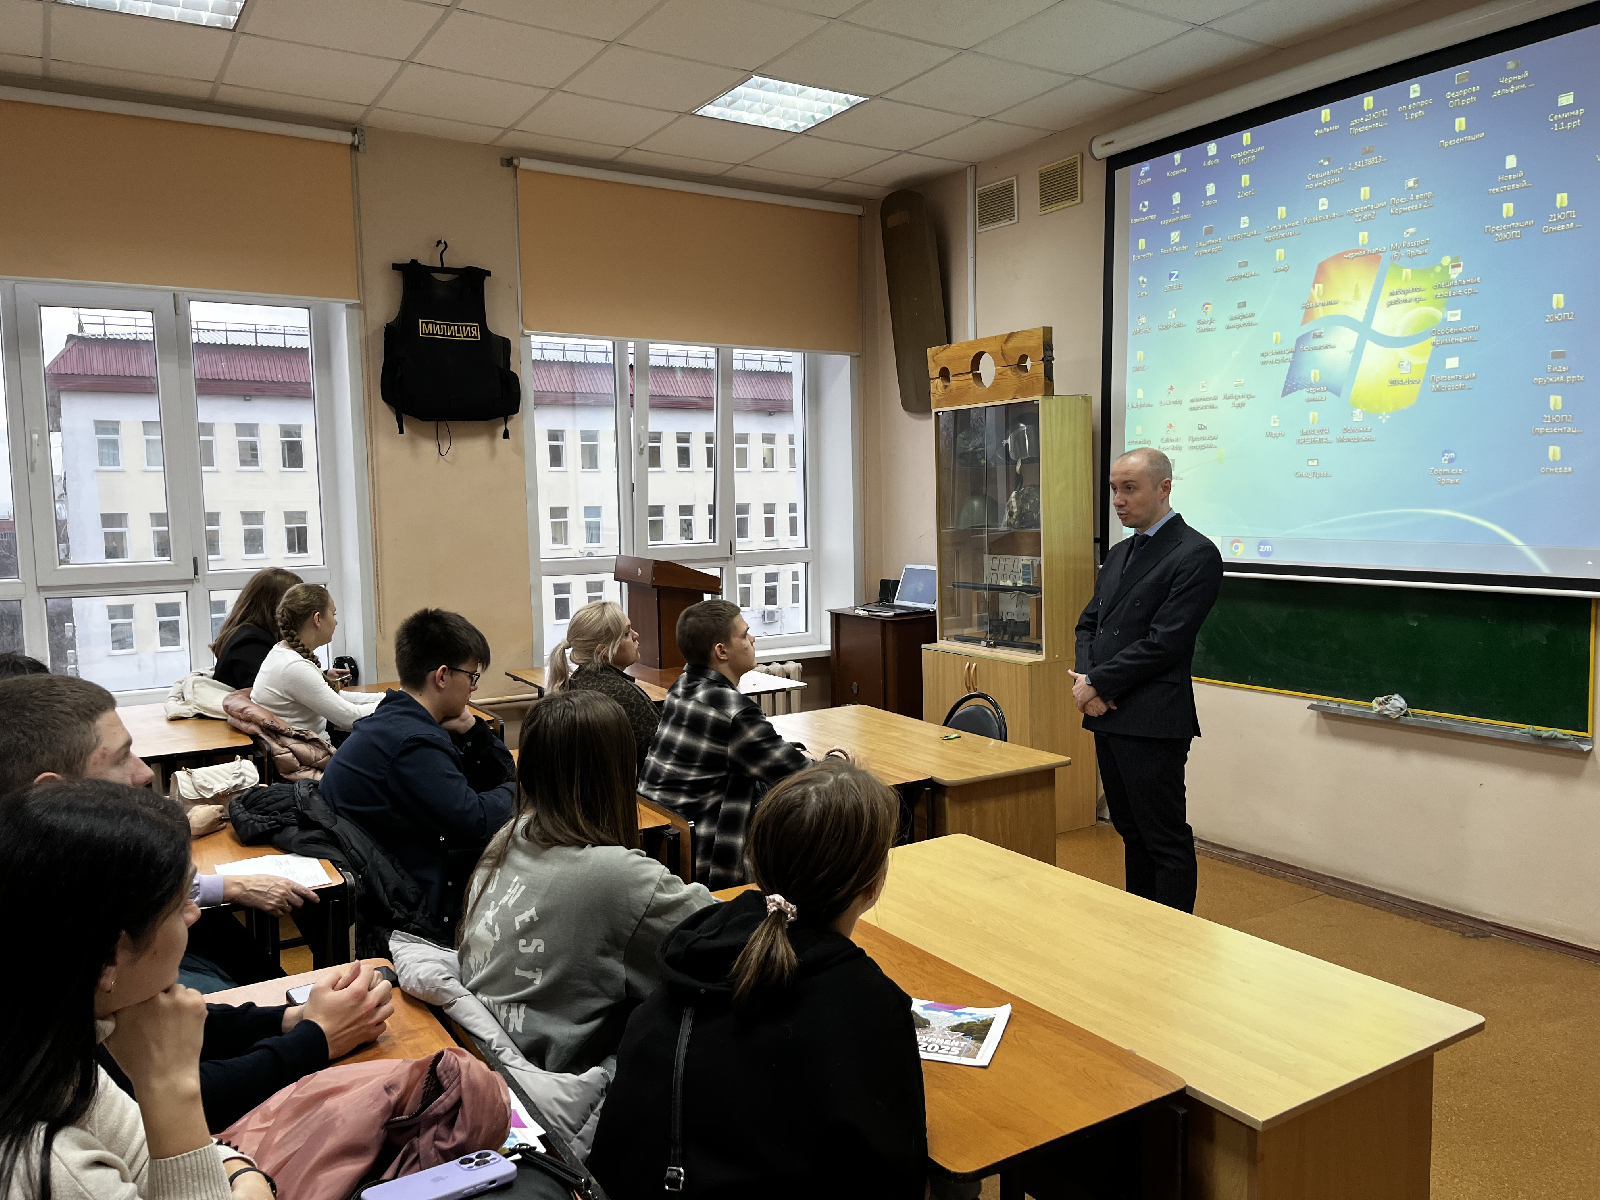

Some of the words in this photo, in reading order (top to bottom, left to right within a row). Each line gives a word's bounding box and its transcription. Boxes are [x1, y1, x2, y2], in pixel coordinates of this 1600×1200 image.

[1548, 108, 1585, 122] Семинар
[1438, 132, 1485, 148] Презентации
[1498, 171, 1524, 182] Новый
[422, 323, 478, 338] МИЛИЦИЯ
[1431, 325, 1480, 336] Особенности
[1547, 364, 1569, 372] Виды
[918, 1042, 961, 1055] 2025
